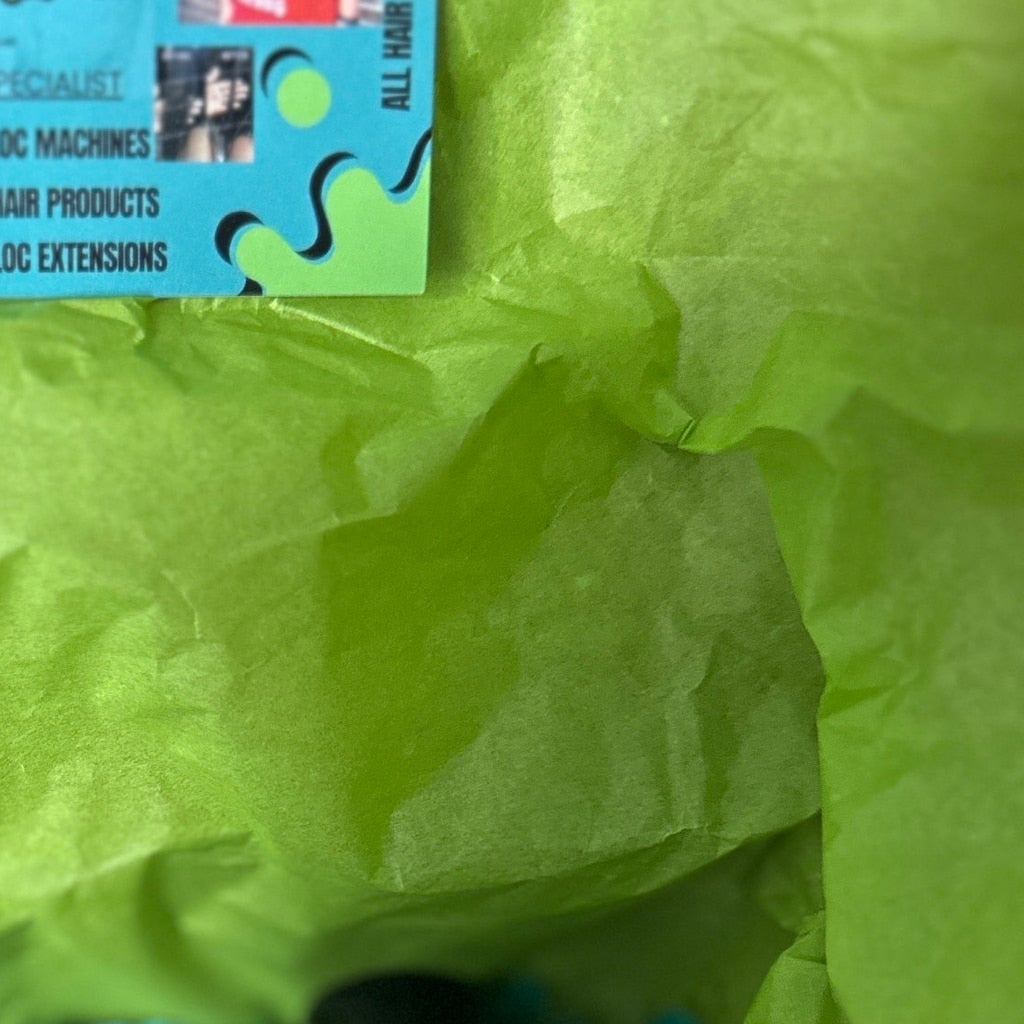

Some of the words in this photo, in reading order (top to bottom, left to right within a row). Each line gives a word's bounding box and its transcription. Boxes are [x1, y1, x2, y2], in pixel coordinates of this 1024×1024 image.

[383, 1, 414, 59] HAIR
[381, 67, 412, 111] ALL
[35, 128, 151, 160] MACHINES
[46, 186, 160, 219] PRODUCTS
[37, 241, 169, 274] EXTENSIONS
